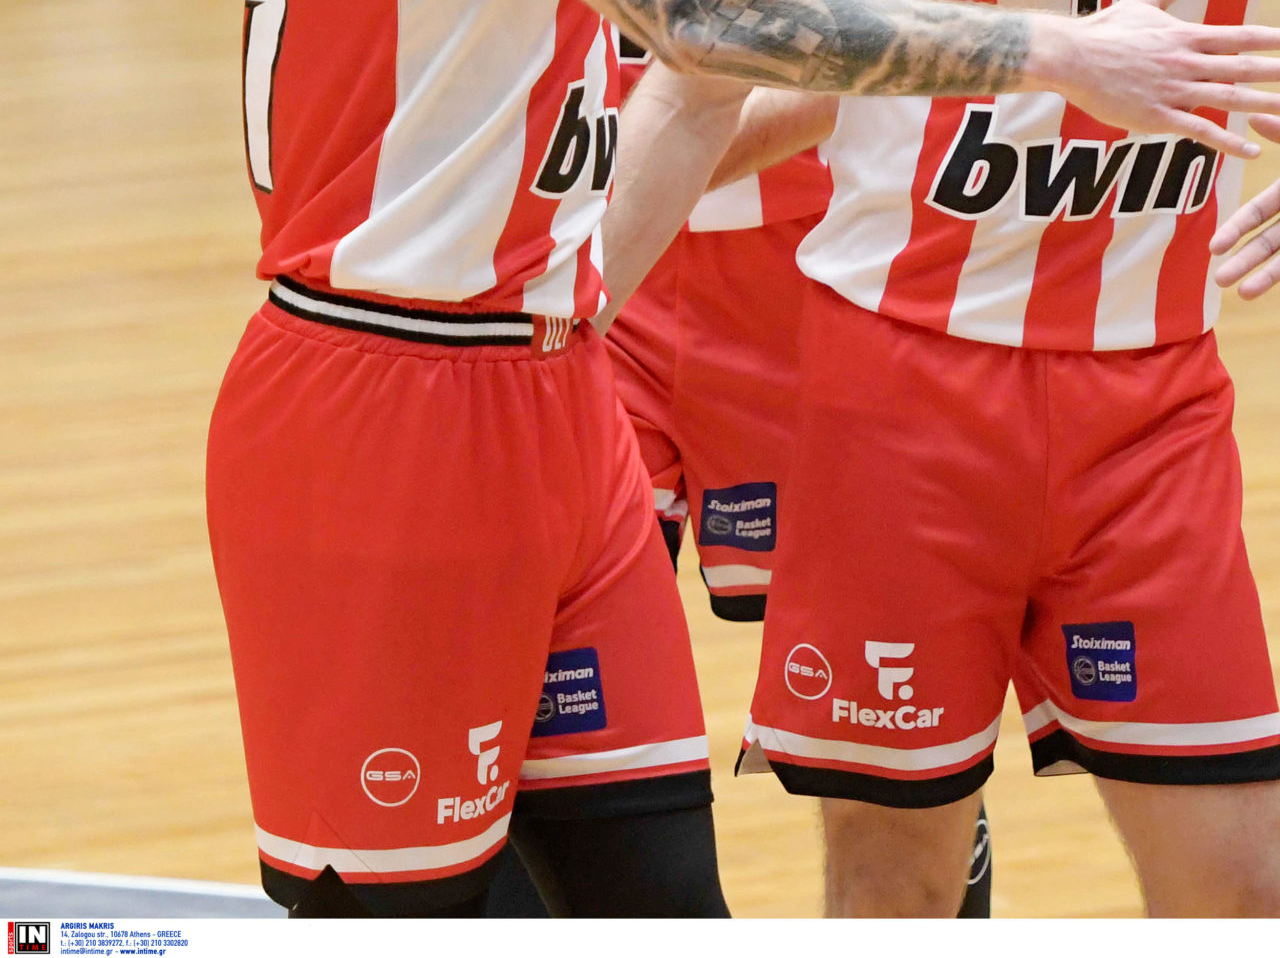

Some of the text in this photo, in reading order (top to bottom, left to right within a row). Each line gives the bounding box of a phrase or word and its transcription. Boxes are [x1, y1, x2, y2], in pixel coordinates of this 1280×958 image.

[931, 108, 1222, 217] bwin
[707, 498, 771, 513] Stoiximan
[736, 517, 772, 529] Basket
[735, 528, 772, 539] League
[1071, 635, 1131, 650] Stoiximan
[788, 661, 828, 681] GSA
[1097, 660, 1131, 672] Basket
[1098, 671, 1132, 684] League
[556, 689, 598, 704] Basket
[558, 701, 599, 714] League
[831, 698, 944, 731] FlexCar
[366, 770, 416, 782] GSA
[436, 780, 510, 825] FlexCar
